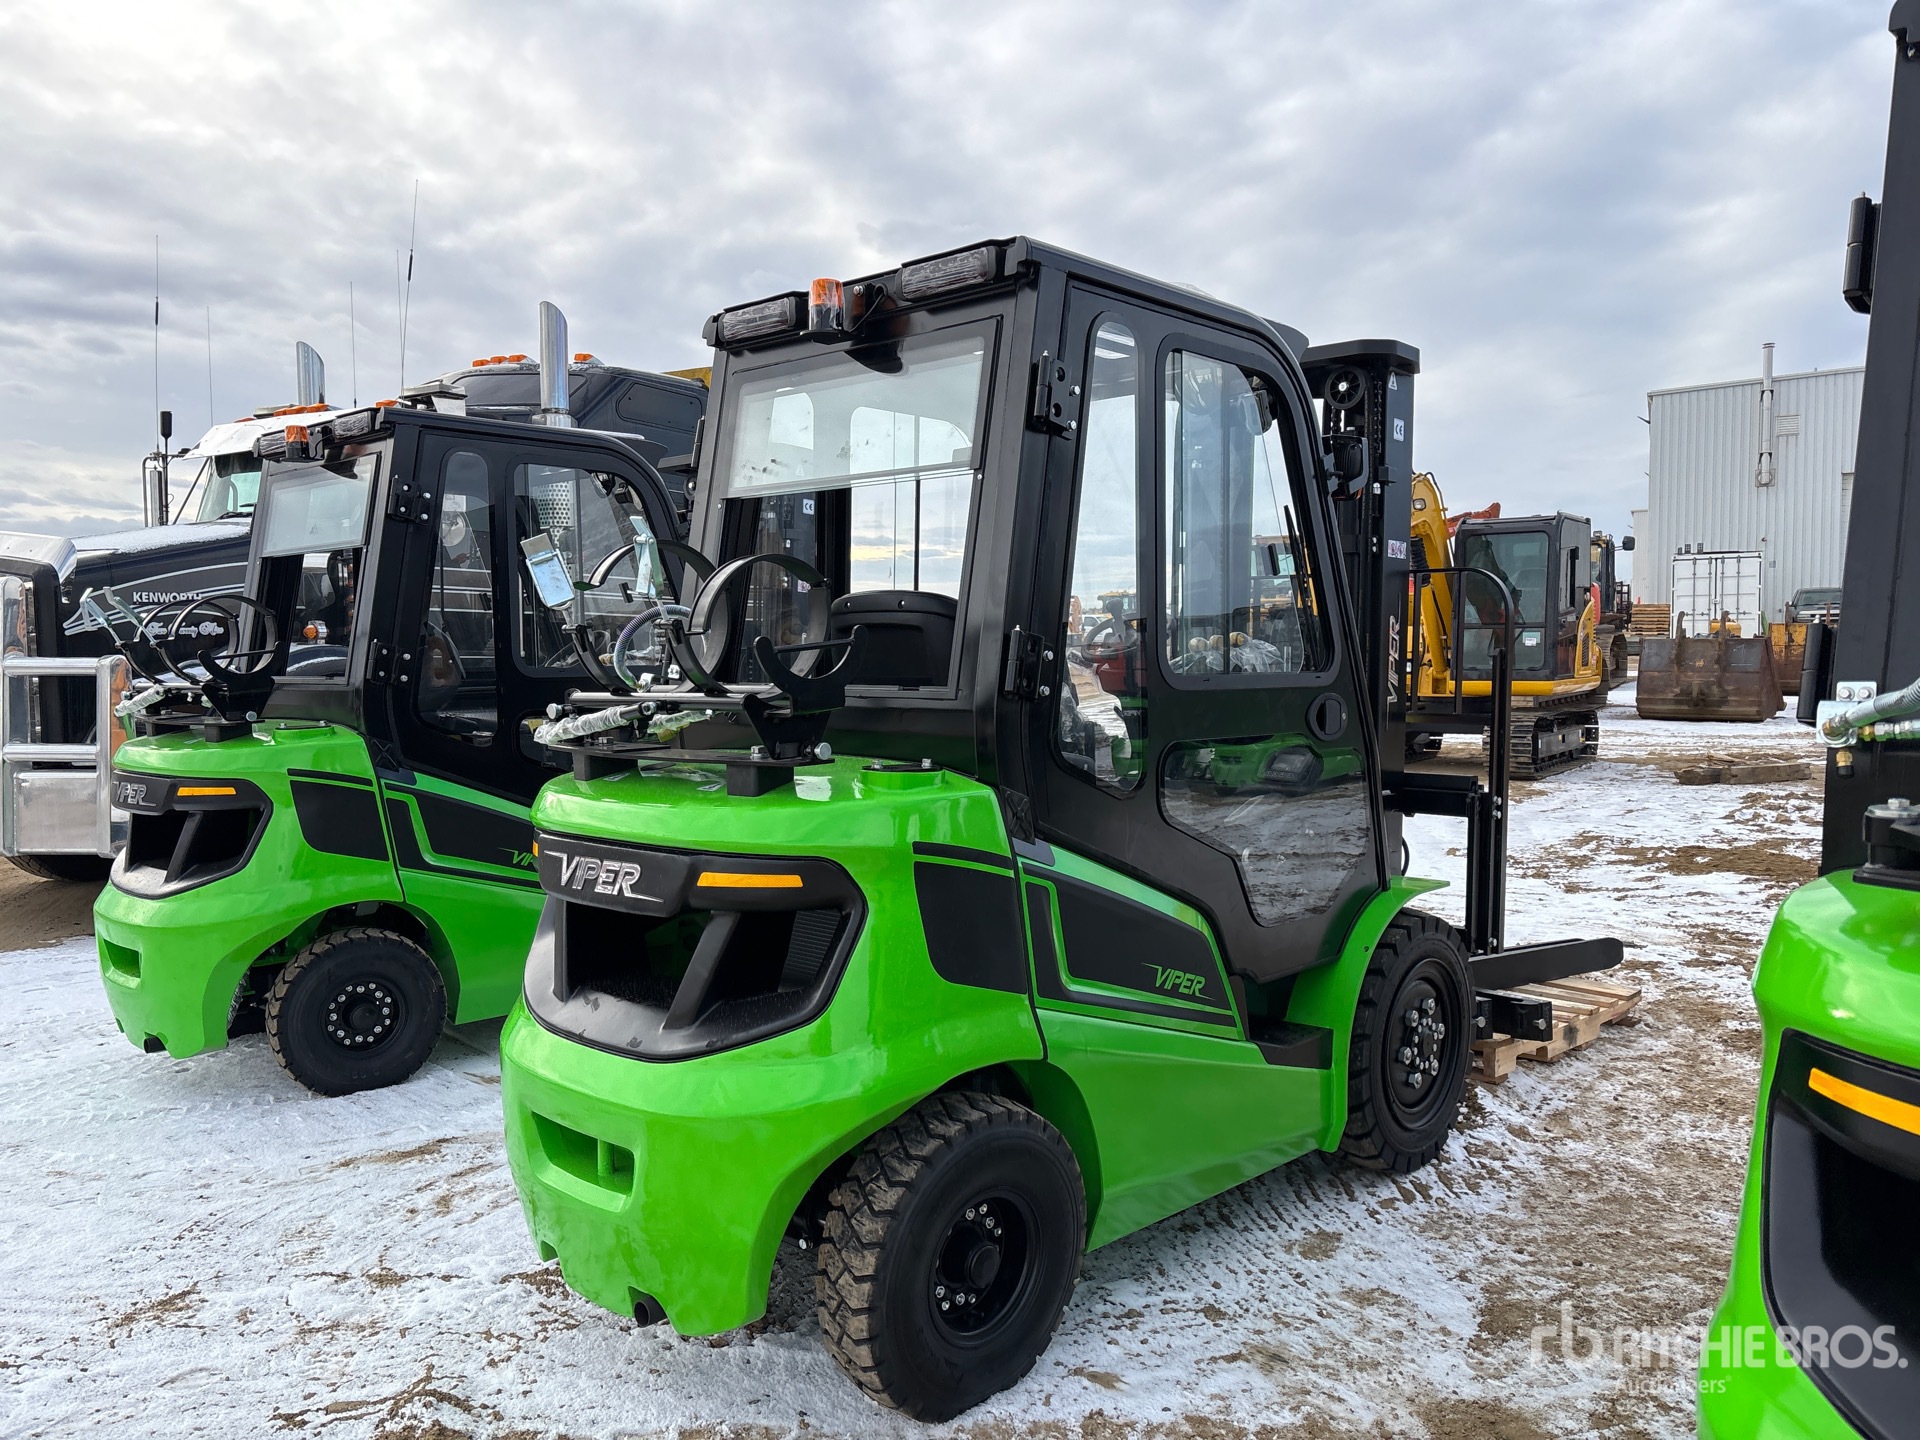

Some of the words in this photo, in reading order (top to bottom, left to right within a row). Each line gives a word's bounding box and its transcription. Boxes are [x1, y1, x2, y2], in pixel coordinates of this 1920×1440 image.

[1386, 592, 1401, 731] VIPER
[112, 781, 157, 806] VIPER
[543, 850, 664, 902] VIPER
[1141, 962, 1216, 1000] VIPER
